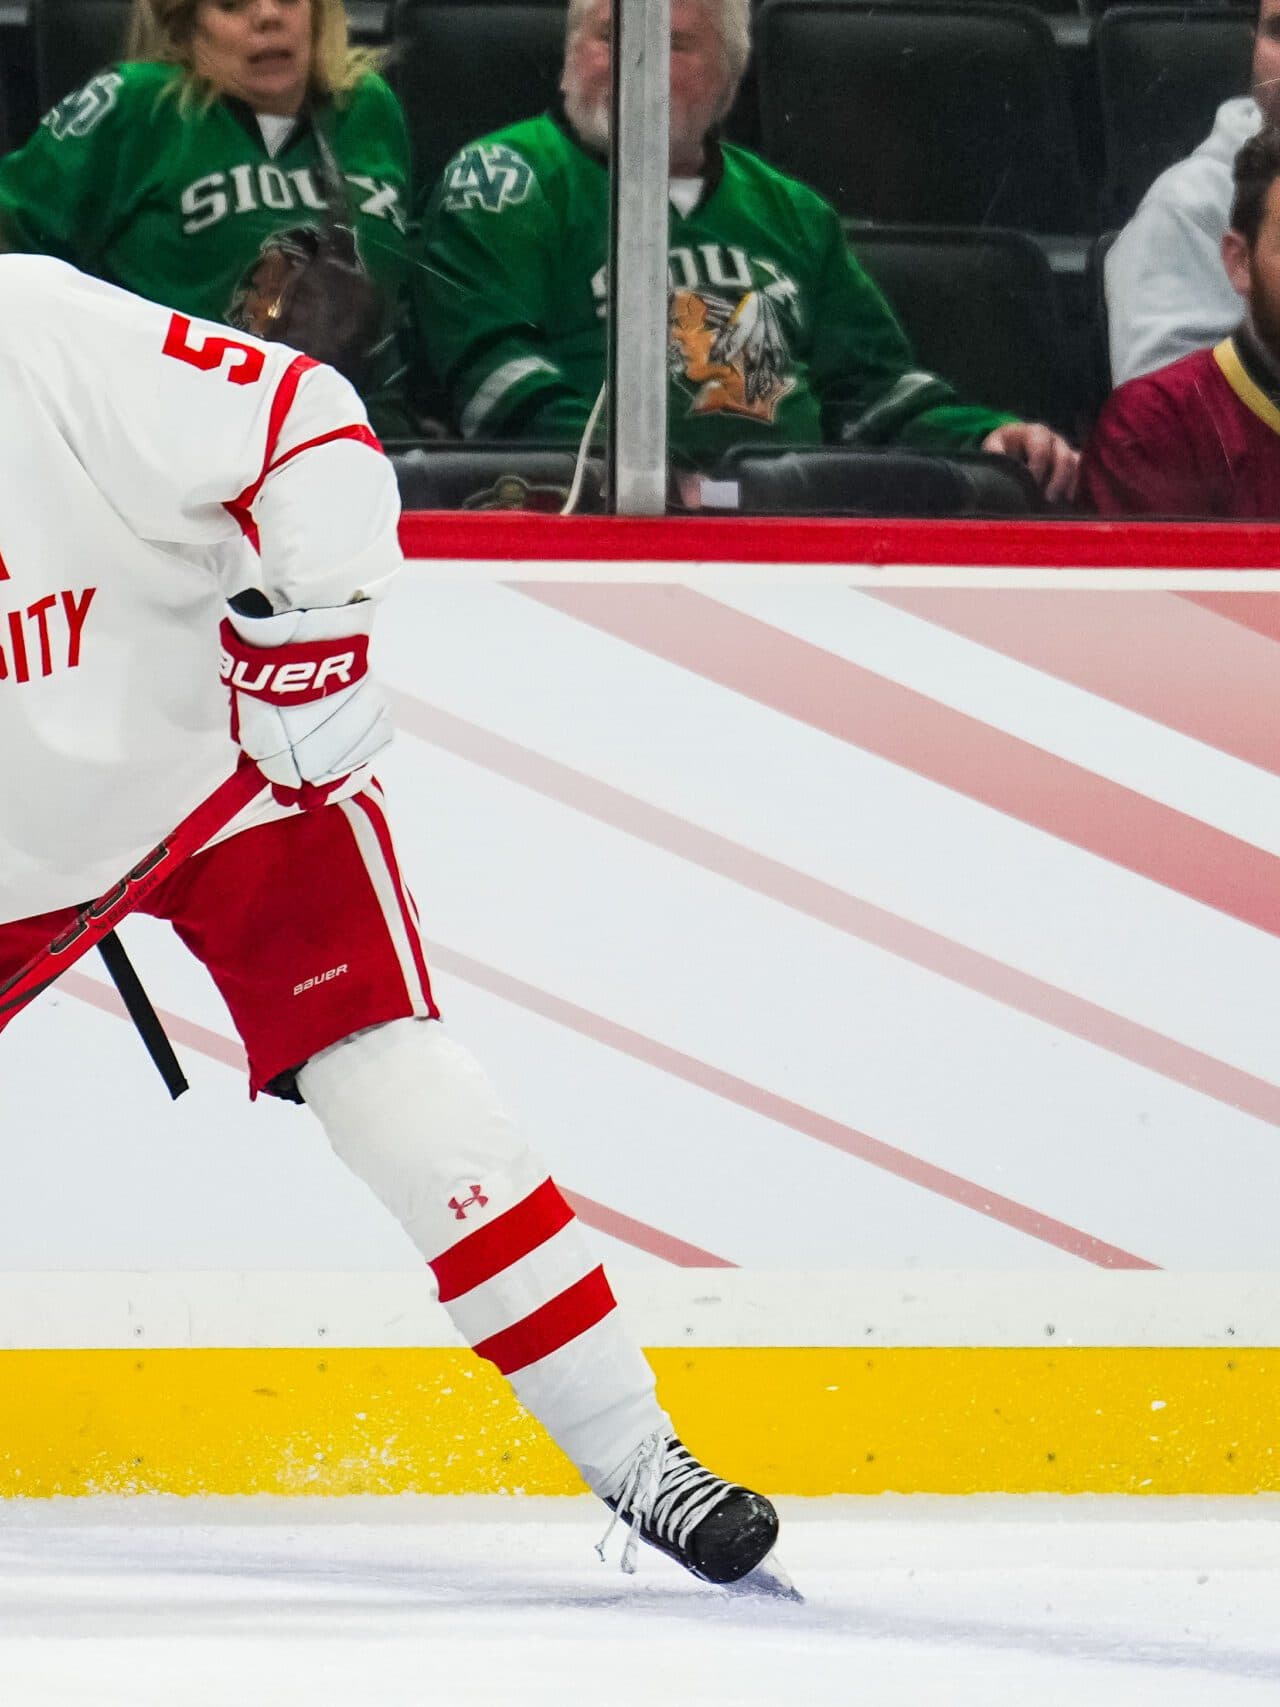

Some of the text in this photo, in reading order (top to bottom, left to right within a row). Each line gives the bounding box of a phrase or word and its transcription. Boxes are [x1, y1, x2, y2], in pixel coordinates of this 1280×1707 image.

[162, 312, 266, 386] 5
[220, 650, 355, 694] AUER
[293, 964, 348, 996] BAUER
